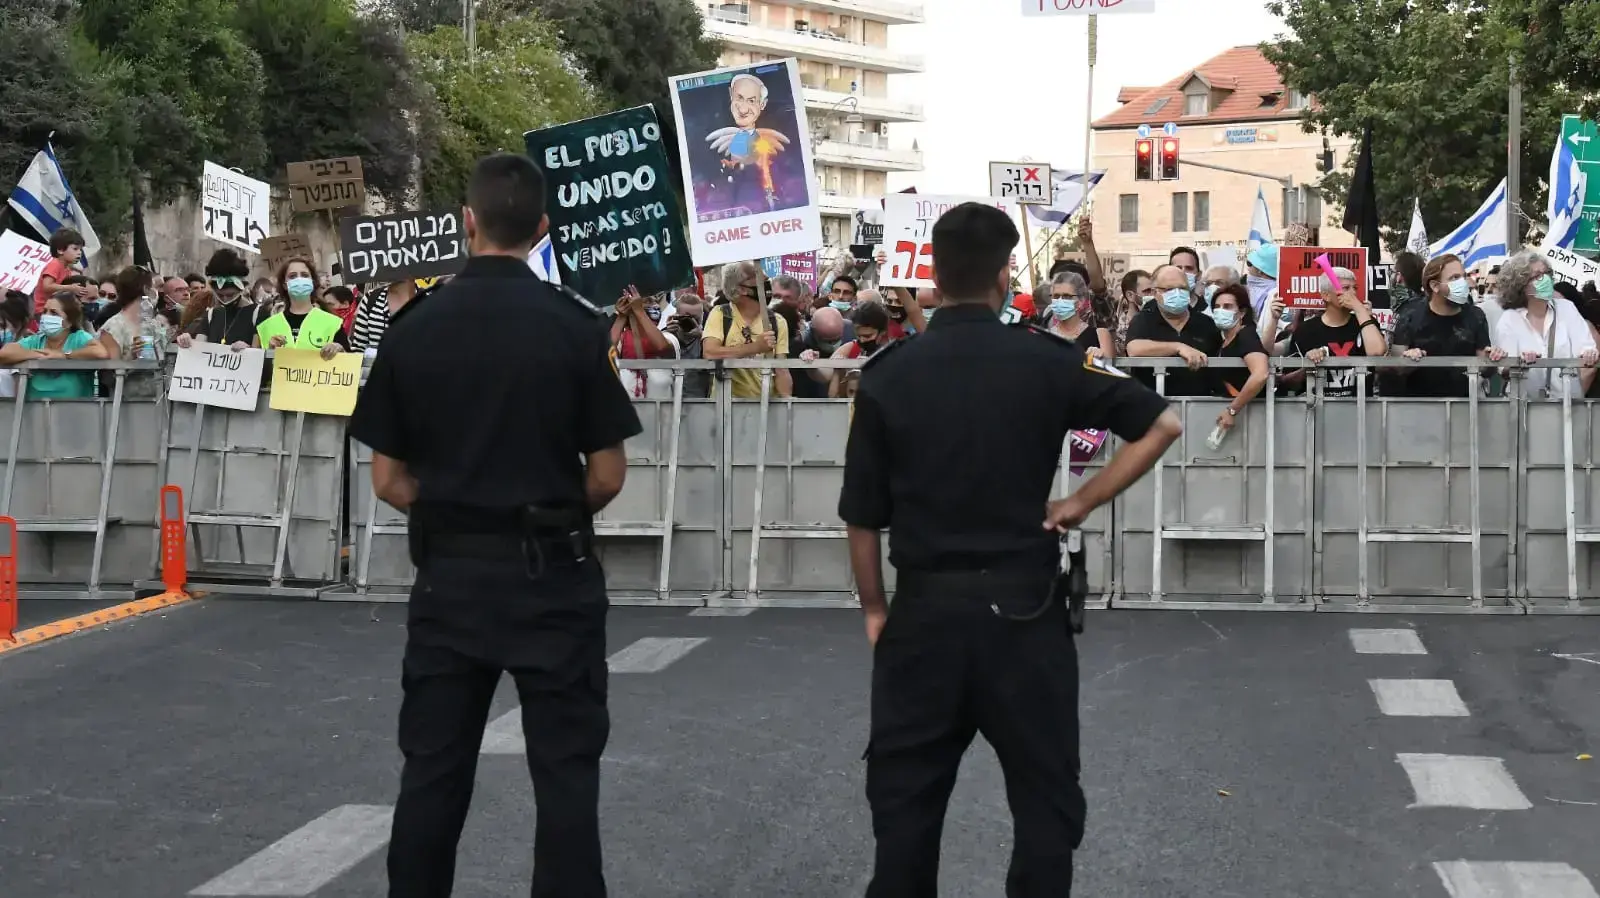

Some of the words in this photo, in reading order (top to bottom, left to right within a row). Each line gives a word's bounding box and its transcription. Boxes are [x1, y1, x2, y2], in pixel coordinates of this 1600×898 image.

[544, 144, 582, 169] EL
[311, 160, 352, 177] ביבי
[297, 182, 357, 204] תתפטר
[557, 164, 656, 208] UNIDO
[1001, 182, 1042, 198] רווק
[356, 213, 457, 248] מנותקים
[558, 211, 619, 244] JAMAS
[704, 226, 751, 244] GAME
[760, 218, 804, 236] OVER
[19, 245, 52, 262] שלח
[349, 239, 459, 278] נמאסתם
[561, 234, 657, 272] VENCIDO
[1547, 249, 1578, 268] לחלום
[15, 260, 41, 275] את
[785, 258, 812, 268] פרנסה
[202, 351, 242, 371] שוטר
[172, 375, 203, 391] חבר
[278, 366, 313, 384] שוטר
[209, 378, 250, 396] אתה
